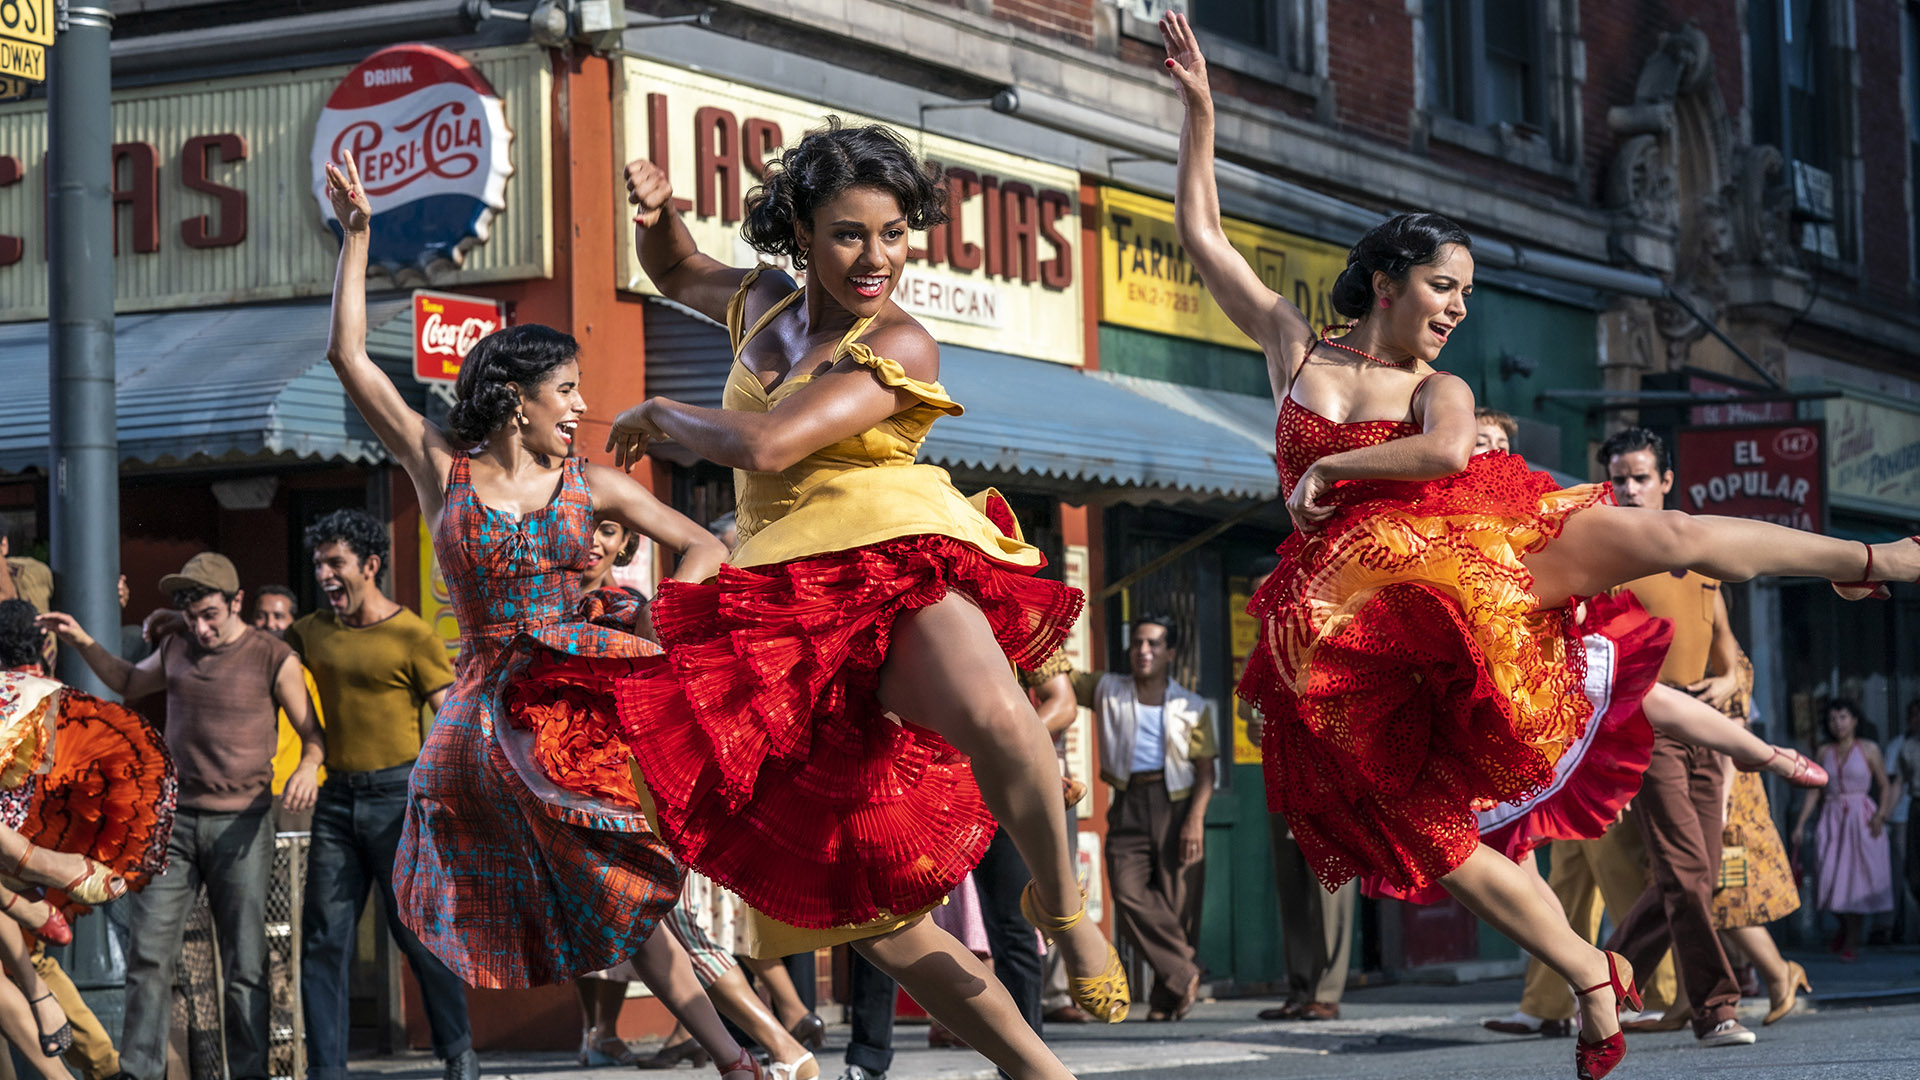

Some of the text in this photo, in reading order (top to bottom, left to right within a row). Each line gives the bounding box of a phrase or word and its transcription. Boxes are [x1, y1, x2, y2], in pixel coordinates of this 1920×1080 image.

[363, 66, 413, 87] DRINK
[1734, 440, 1765, 465] EL
[1782, 434, 1810, 452] 147
[1689, 472, 1810, 509] POPULAR
